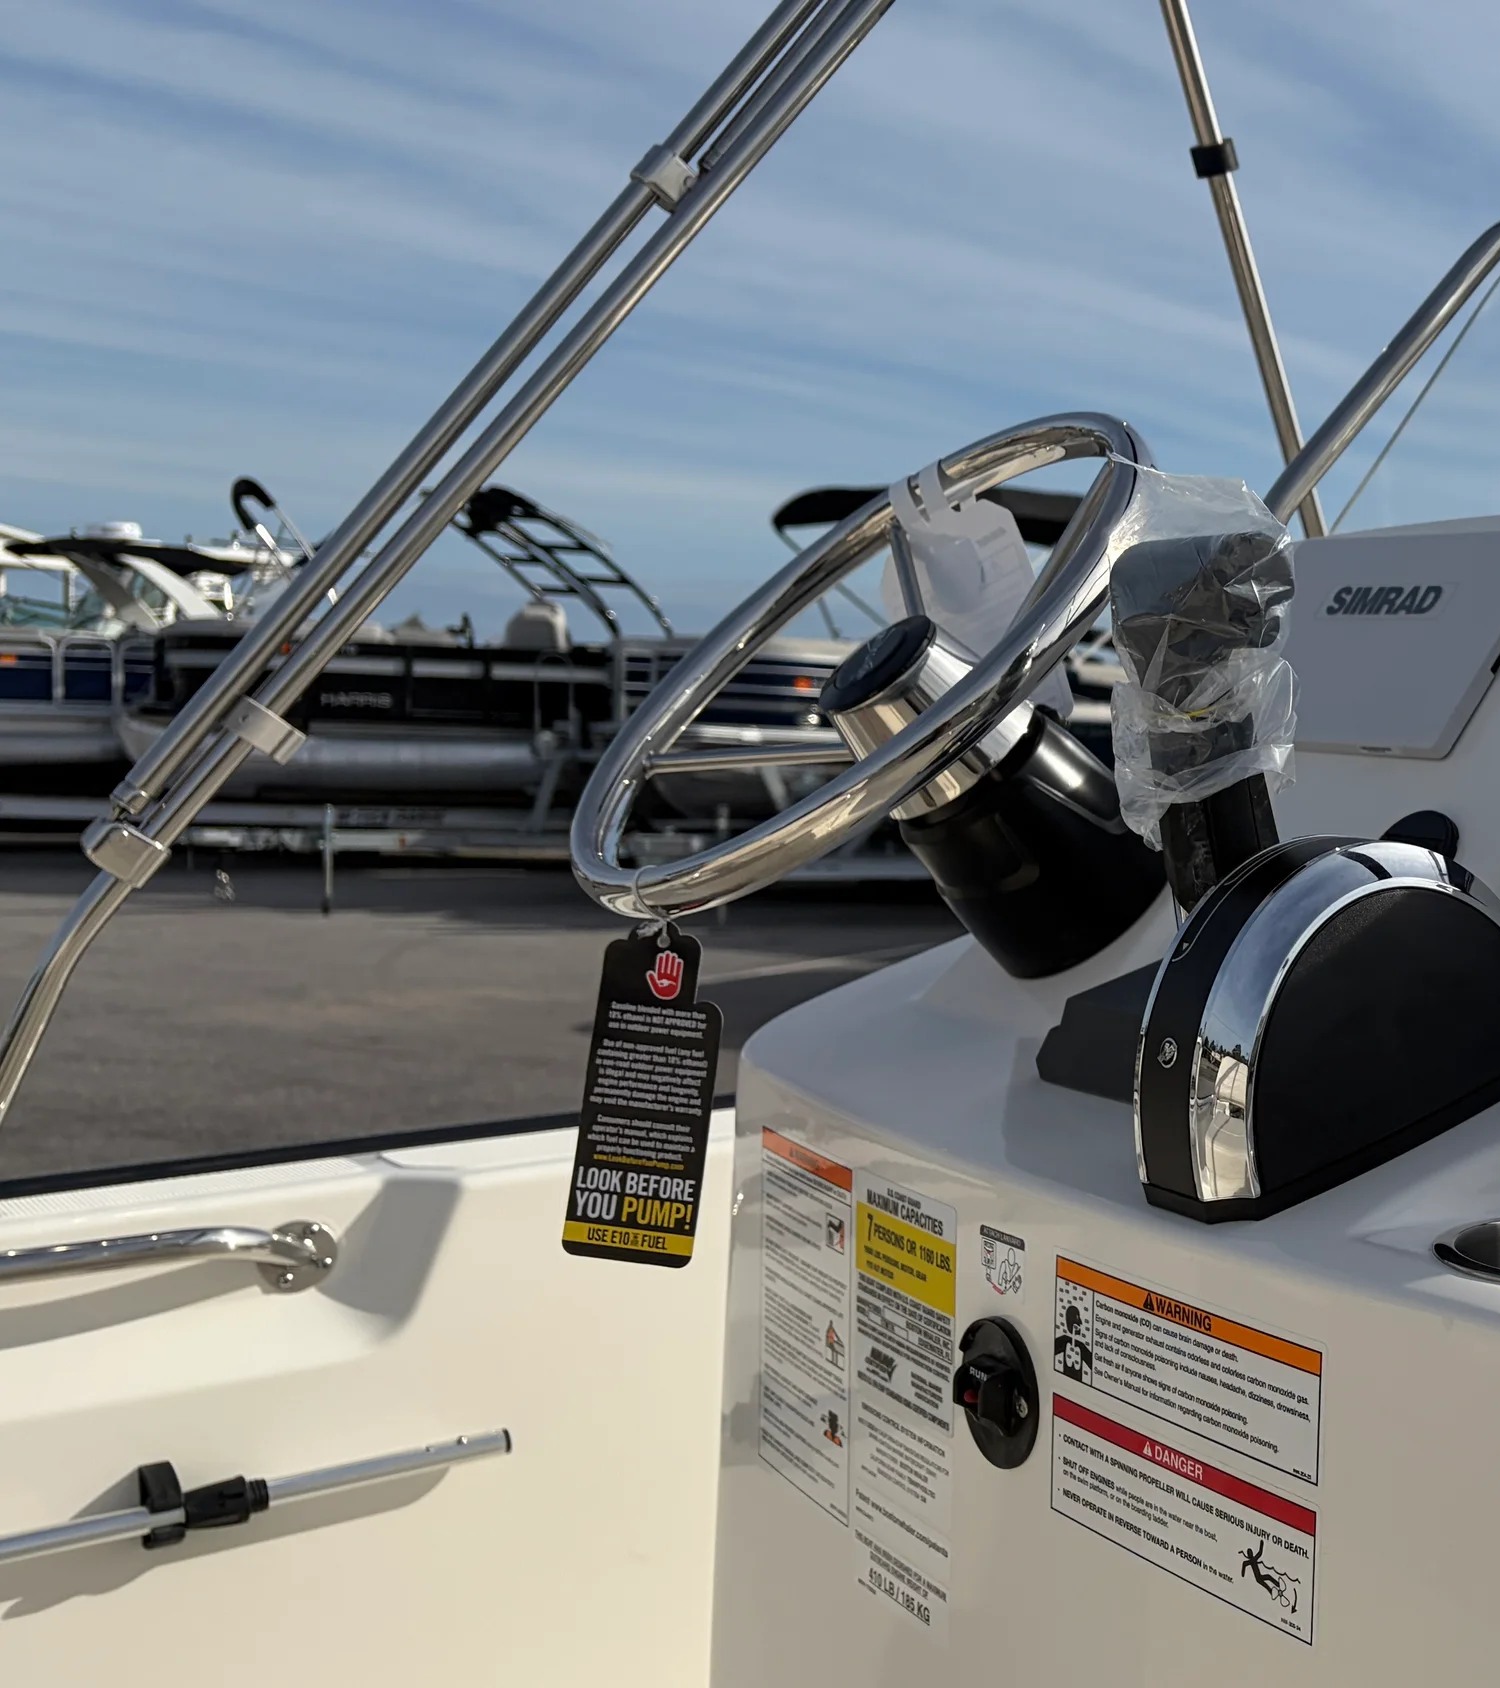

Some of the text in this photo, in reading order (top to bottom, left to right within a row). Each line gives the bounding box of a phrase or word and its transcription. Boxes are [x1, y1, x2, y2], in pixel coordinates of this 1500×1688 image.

[1325, 585, 1443, 616] SIMRAD
[571, 1188, 692, 1231] YOU PUMP!
[575, 1164, 696, 1203] LOOK BEFORE
[867, 1188, 943, 1236] MAXIMUM CAPACITIES
[586, 1227, 609, 1242] USE
[610, 1230, 629, 1245] E10
[640, 1233, 667, 1250] FUEL
[867, 1213, 873, 1241] 7
[873, 1223, 904, 1251] PERSONS
[906, 1239, 916, 1256] OR
[936, 1252, 952, 1273] LBS.
[1095, 1300, 1238, 1362] Carbon monoxide (CO) can cause brain damage or death.
[1155, 1296, 1211, 1332] WARNING
[970, 1366, 988, 1381] RUN
[1094, 1338, 1156, 1371] and lack of consciousness.
[1095, 1313, 1308, 1407] Engine and generator exhaust contains odorless and colorless carbon monoxide gas.
[1095, 1327, 1310, 1424] Signs of carbon monoxide poisoning include nausea, headache, dizziness, drowsiness,
[1094, 1352, 1102, 1363] Get
[1103, 1356, 1114, 1368] fresh
[1121, 1363, 1124, 1372] if
[1125, 1367, 1141, 1381] anyone
[1142, 1372, 1157, 1386] shows
[1158, 1379, 1170, 1393] signs
[1172, 1384, 1176, 1394] of
[1177, 1387, 1194, 1402] carbon
[1195, 1394, 1220, 1412] monoxide
[1221, 1405, 1248, 1426] poisoning.
[1094, 1366, 1102, 1377] See
[1103, 1370, 1122, 1386] Owner's
[1123, 1379, 1140, 1393] Manual
[1149, 1390, 1176, 1408] information
[1177, 1402, 1201, 1421] regarding
[1203, 1412, 1221, 1428] carbon
[1222, 1421, 1248, 1440] monoxide
[1250, 1432, 1279, 1454] poisoning.
[1154, 1444, 1202, 1480] DANGER
[1062, 1456, 1077, 1471] SHUT
[1078, 1463, 1088, 1476] OFF
[1090, 1469, 1114, 1489] ENGINES
[1116, 1484, 1127, 1496] while
[1128, 1490, 1143, 1506] people
[1153, 1503, 1158, 1512] in
[1168, 1510, 1181, 1523] water
[1182, 1519, 1193, 1529] near
[1195, 1523, 1203, 1534] the
[1204, 1527, 1217, 1542] boat,
[1063, 1434, 1309, 1560] CONTACT WITH A SPINNING PROPELLER WILL CAUSE SERIOUS INJURY OR DEATH.
[1062, 1487, 1079, 1504] NEVER
[1081, 1497, 1106, 1518] OPERATE
[1107, 1511, 1113, 1522] IN
[1115, 1515, 1141, 1536] REVERSE
[1143, 1529, 1168, 1551] TOWARD
[1170, 1543, 1173, 1553] A
[1175, 1547, 1201, 1568] PERSON
[869, 1566, 882, 1589] 410
[884, 1577, 895, 1598] LB
[895, 1585, 900, 1600] /
[901, 1589, 915, 1612] 185
[917, 1602, 931, 1624] KG
